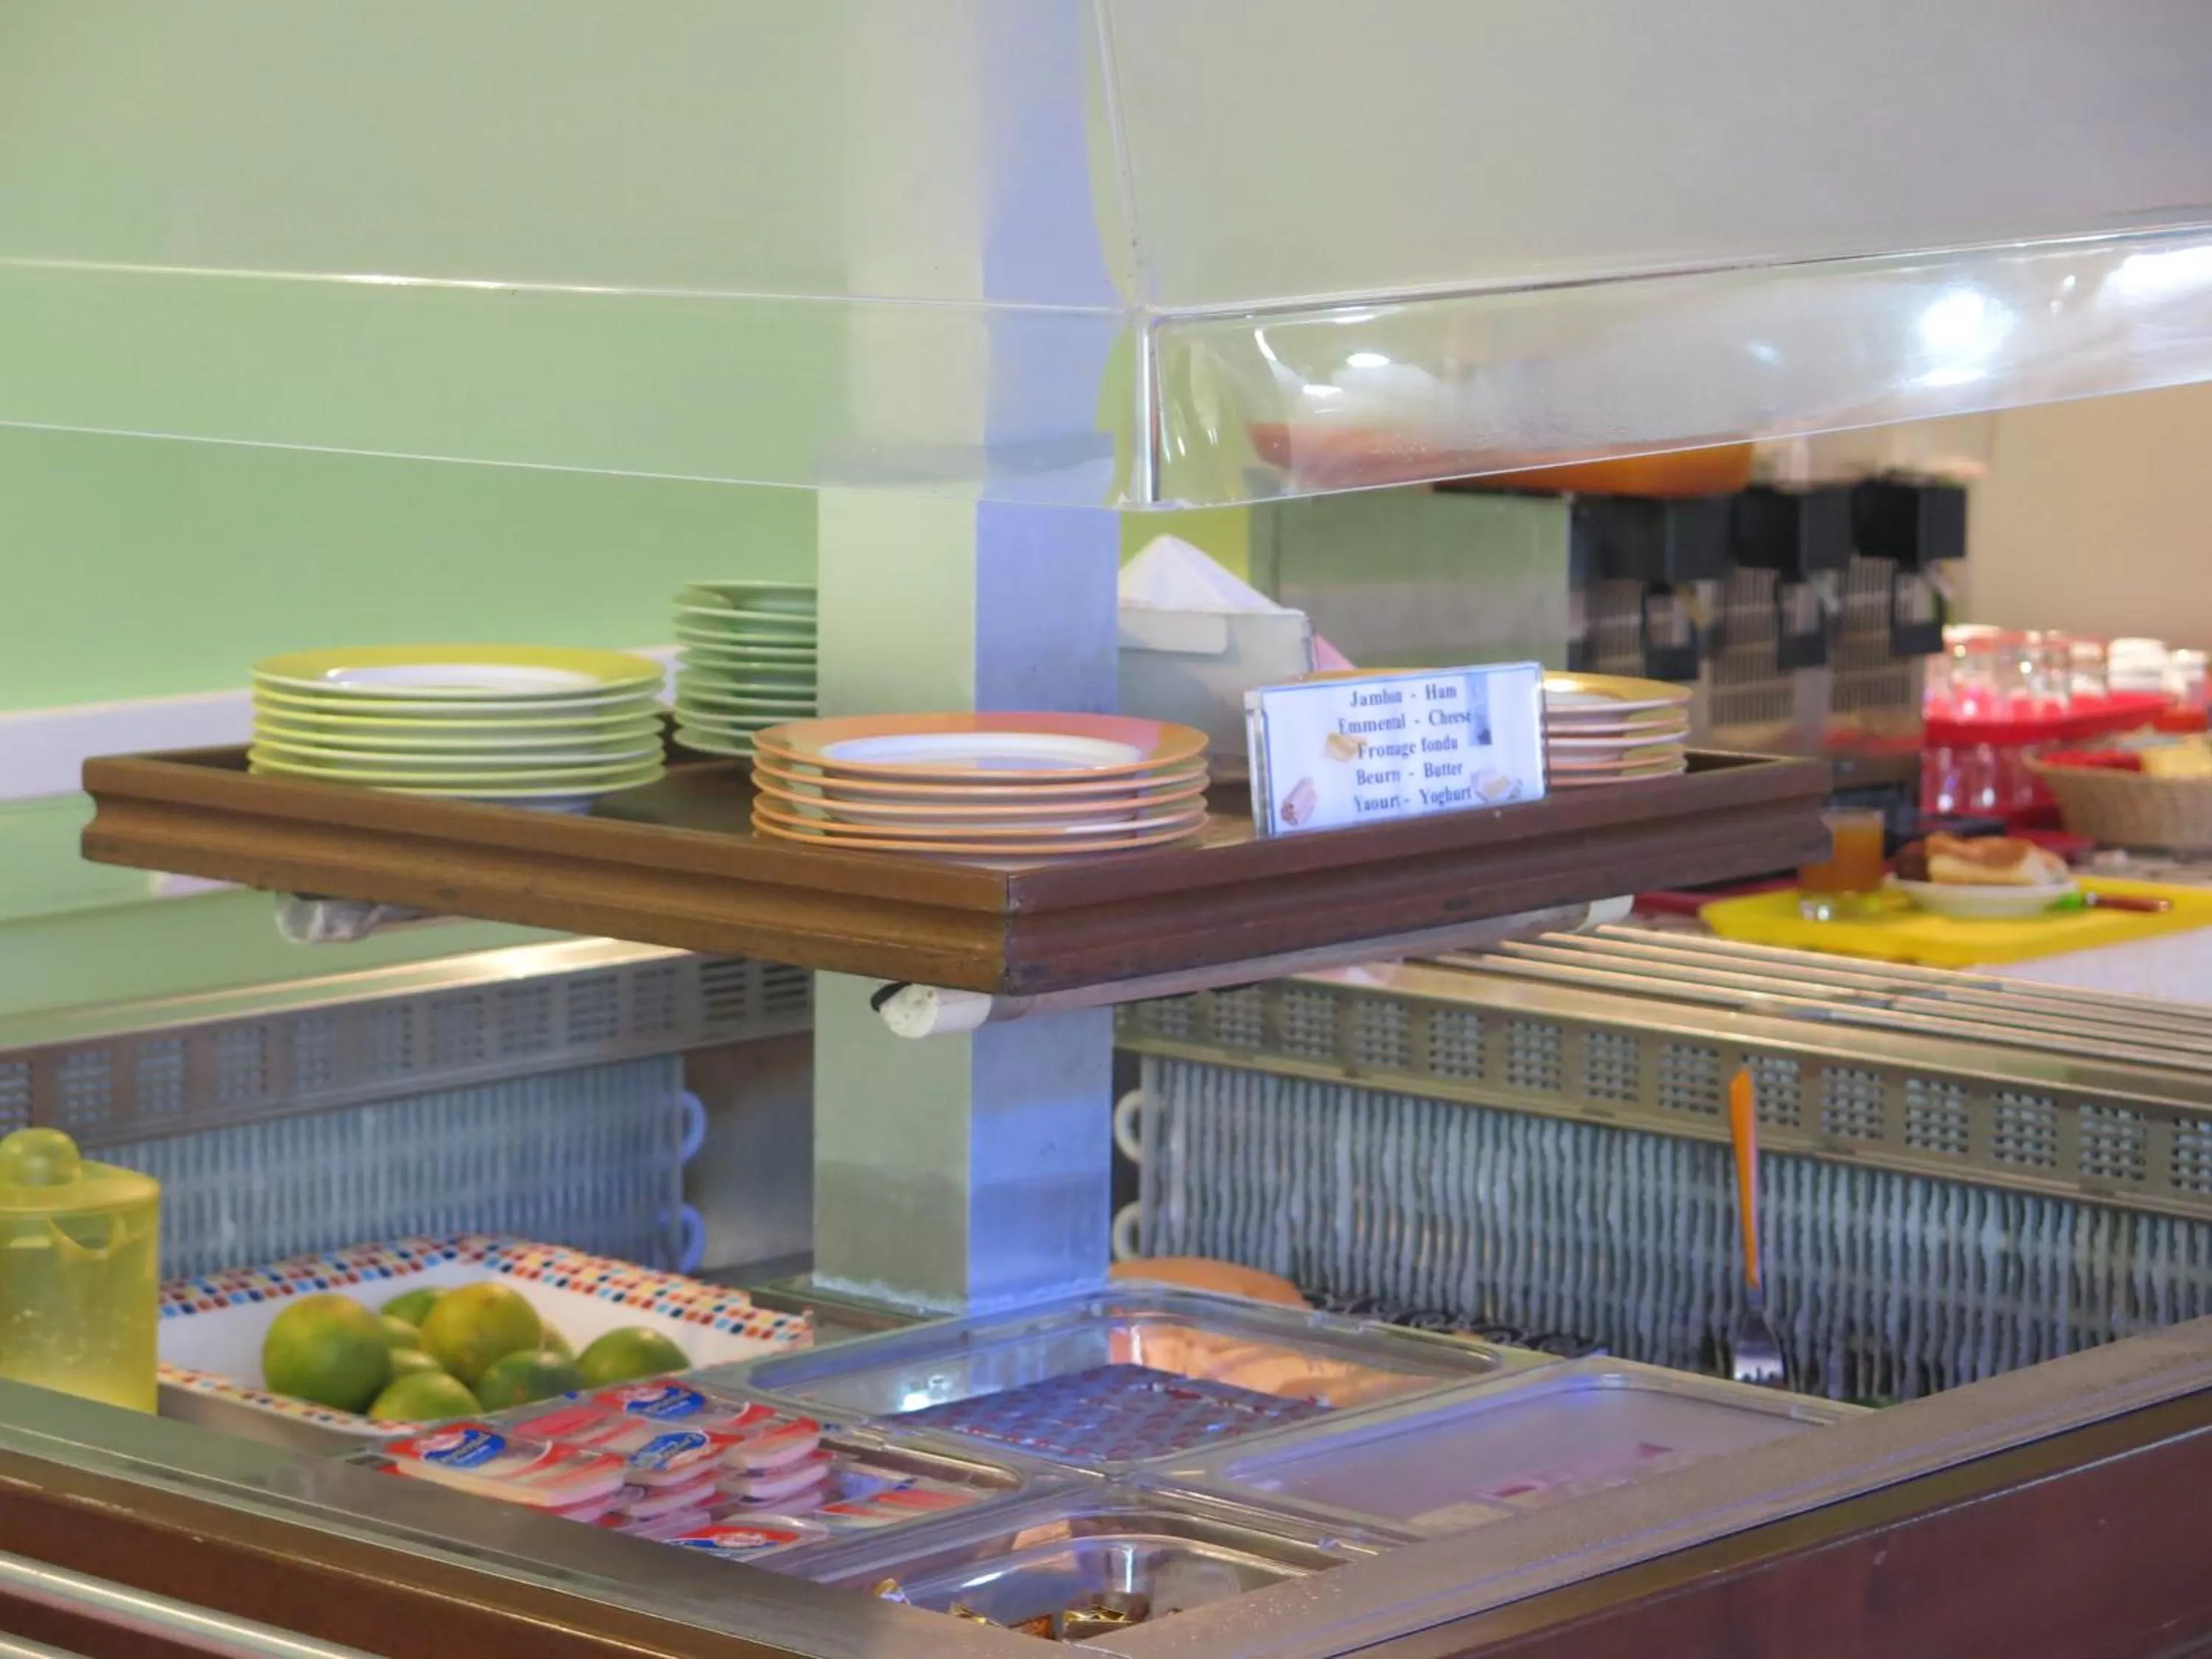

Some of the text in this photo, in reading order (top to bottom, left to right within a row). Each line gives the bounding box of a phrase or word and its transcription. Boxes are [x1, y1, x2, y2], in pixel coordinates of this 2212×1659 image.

[1425, 684, 1457, 700] Ham
[1428, 709, 1472, 726] Cheese
[1422, 735, 1458, 753] fondu
[1424, 762, 1463, 778] Butter
[1419, 785, 1472, 805] Yoghurt
